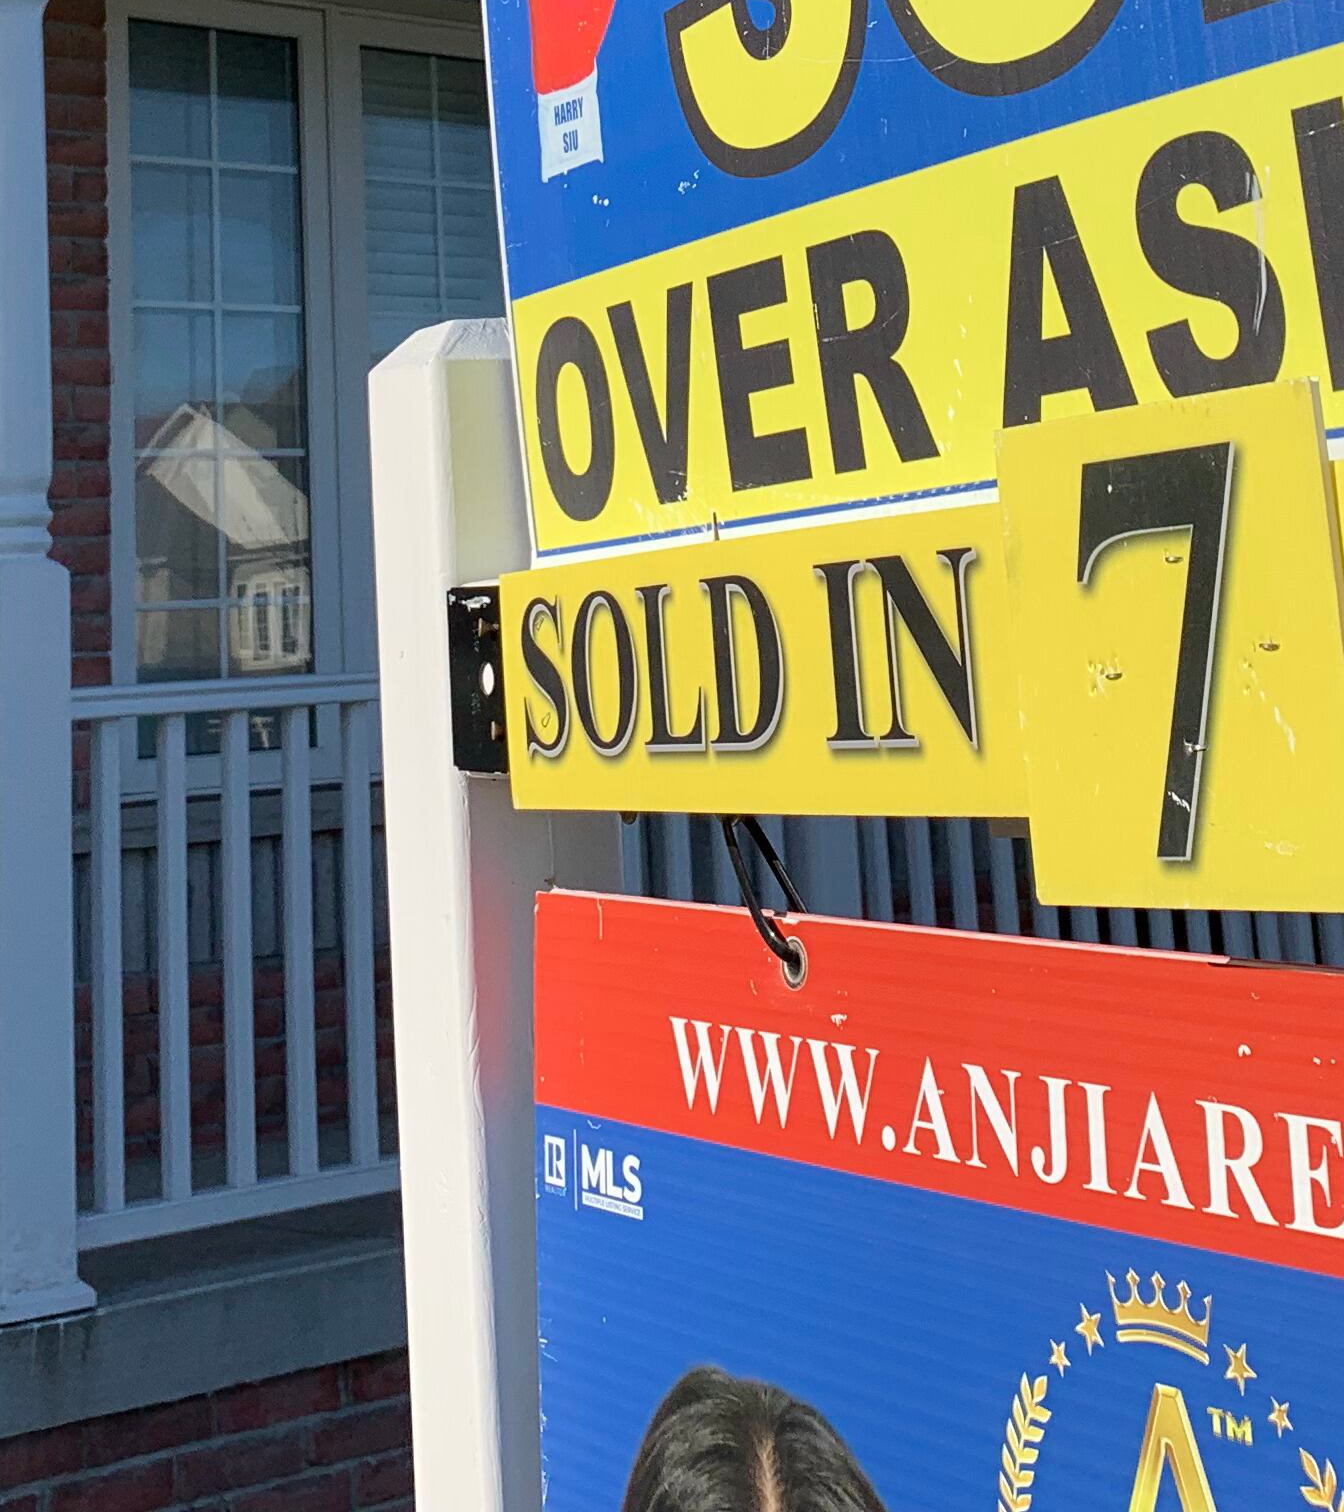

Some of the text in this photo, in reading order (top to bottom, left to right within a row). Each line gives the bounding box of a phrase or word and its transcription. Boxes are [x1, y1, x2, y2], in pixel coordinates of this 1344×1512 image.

[553, 96, 583, 126] HARRY
[562, 129, 579, 153] SIU
[535, 229, 940, 522] OVER
[521, 572, 785, 760] SOLD
[813, 546, 981, 750] IN
[1076, 441, 1236, 862] 7
[581, 1143, 642, 1203] MLS
